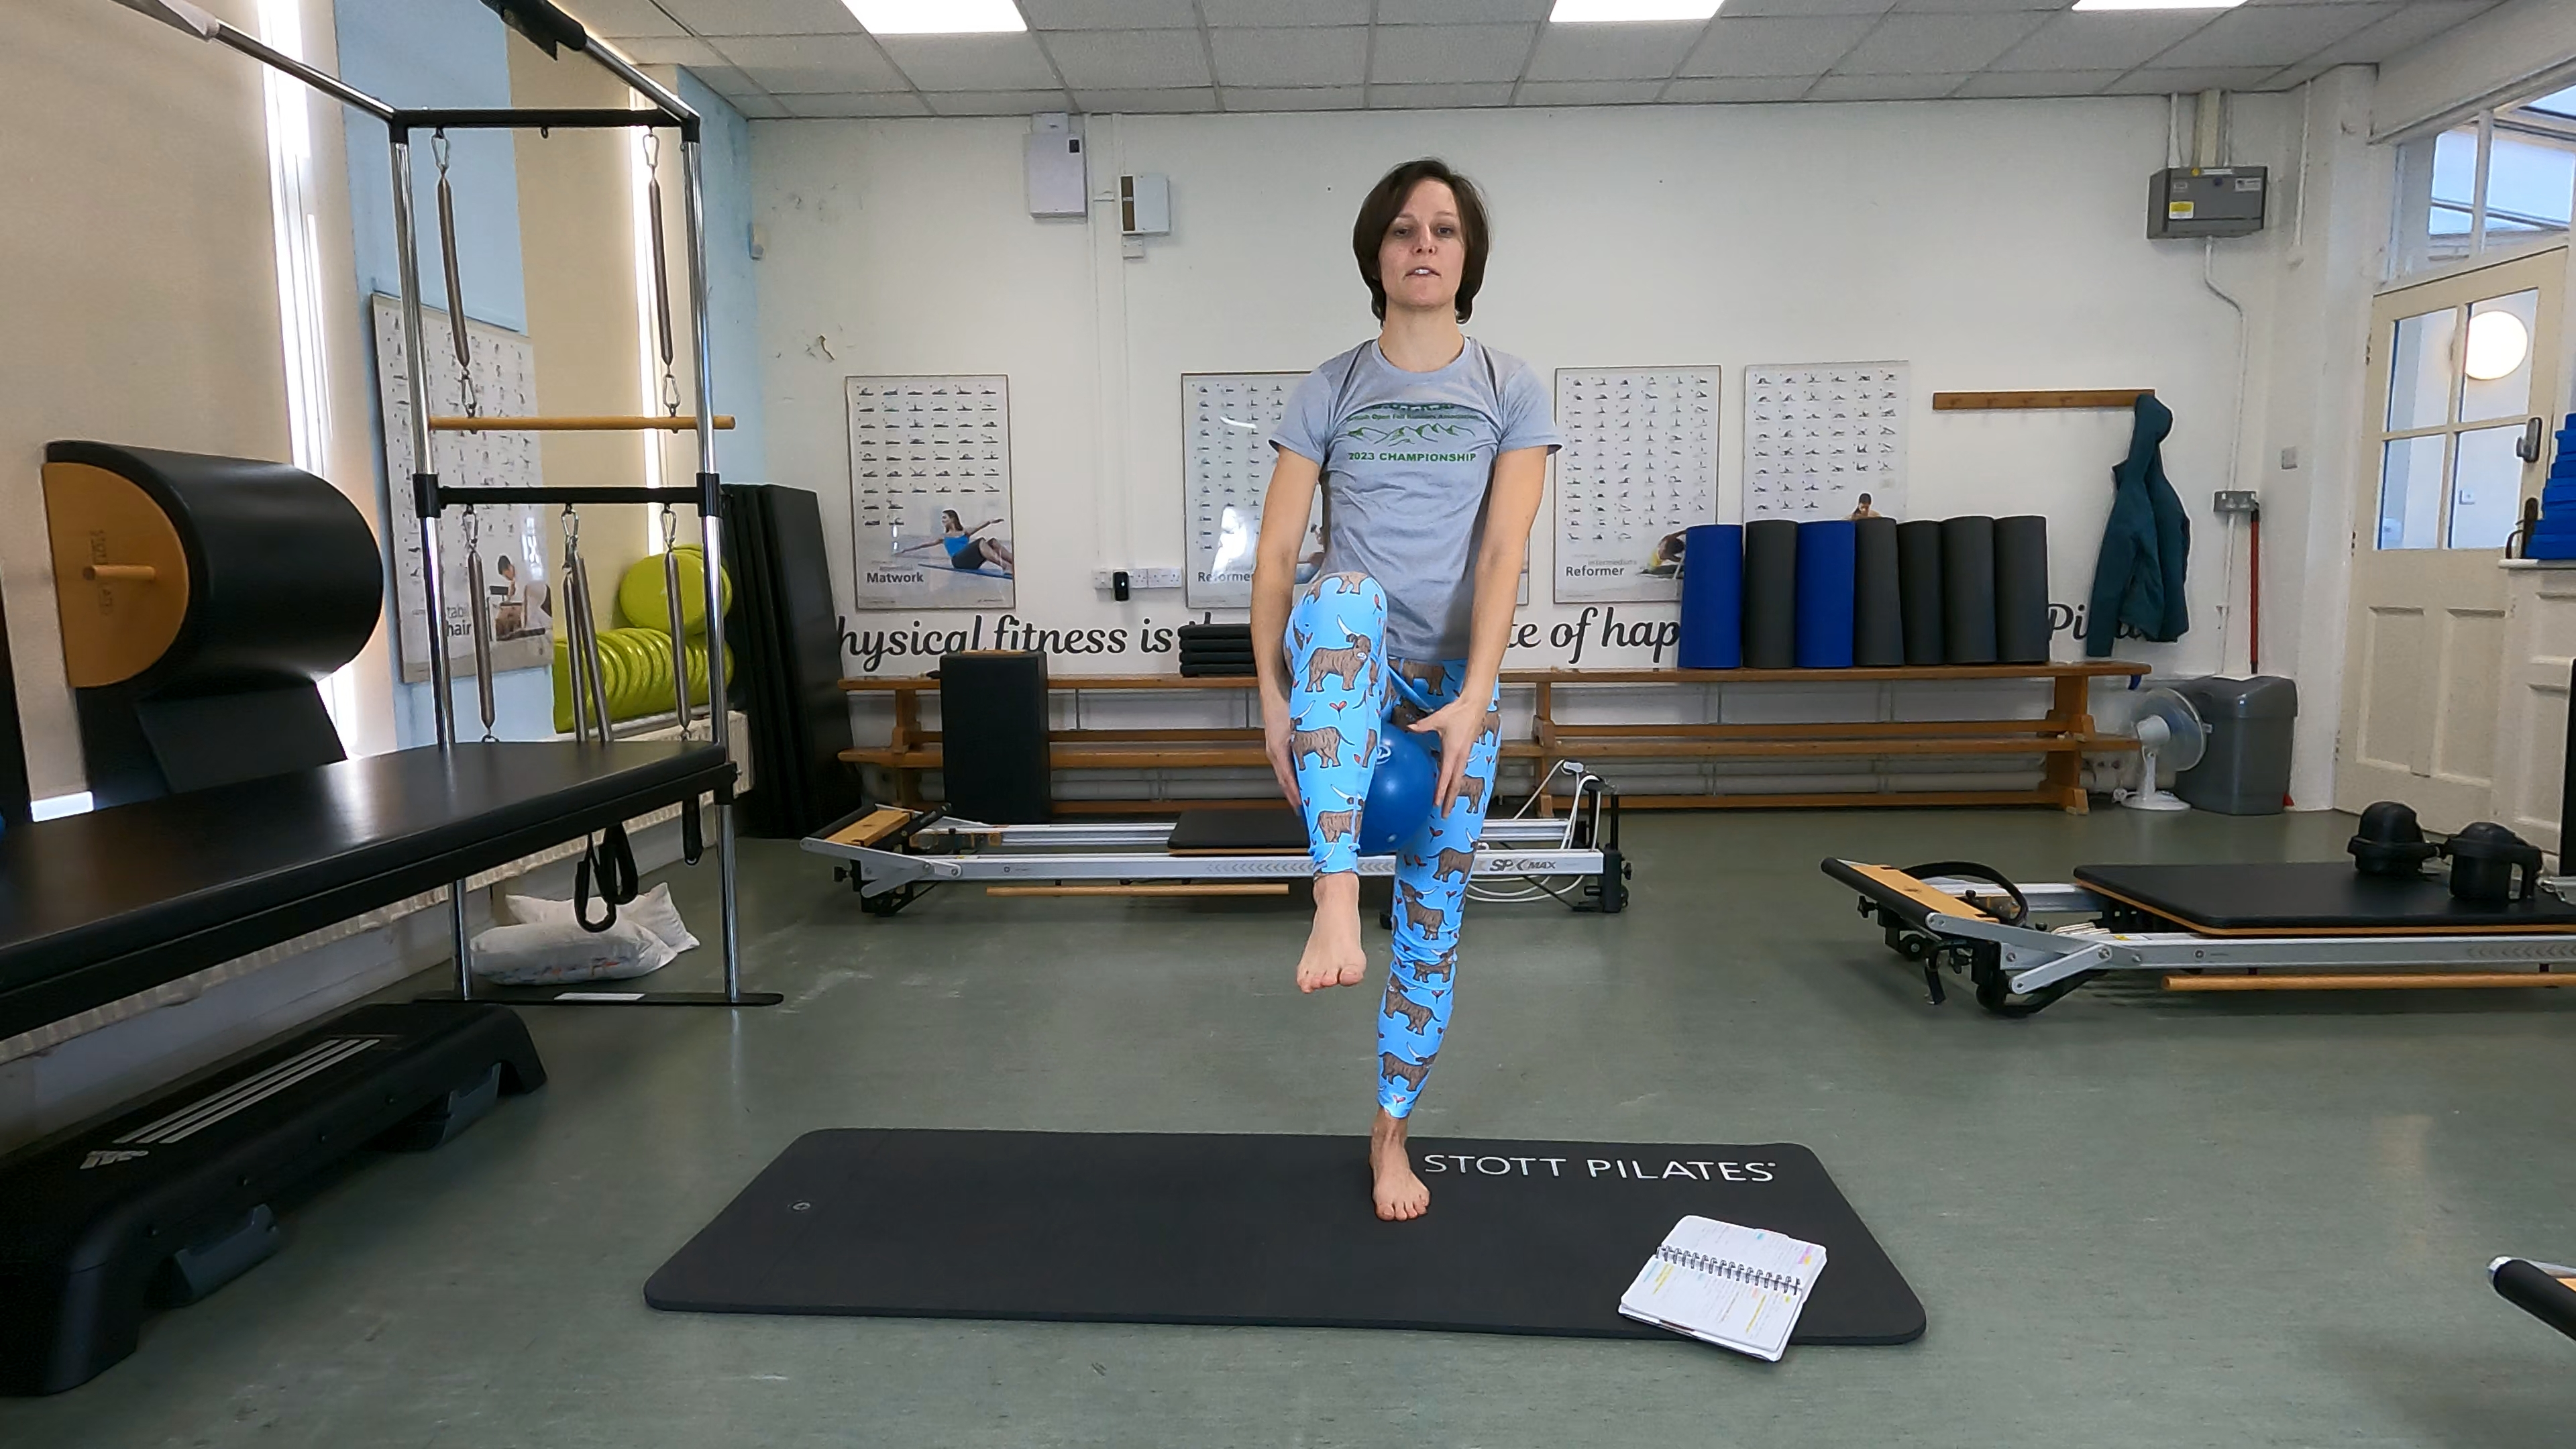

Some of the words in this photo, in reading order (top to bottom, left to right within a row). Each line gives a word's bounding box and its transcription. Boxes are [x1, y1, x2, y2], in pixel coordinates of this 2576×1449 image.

[1348, 452, 1375, 461] 2023
[1379, 452, 1477, 462] CHAMPIONSHIP
[1565, 565, 1625, 577] Reformer
[866, 572, 924, 583] Matwork
[1197, 572, 1254, 582] Reorme
[446, 619, 472, 637] hair
[839, 614, 987, 672] hysical
[994, 614, 1128, 654] fitness
[1140, 618, 1173, 653] is
[1550, 606, 1599, 664] of
[1601, 606, 1680, 663] hap
[1527, 861, 1557, 869] MAX
[1424, 1155, 1566, 1177] STOTT
